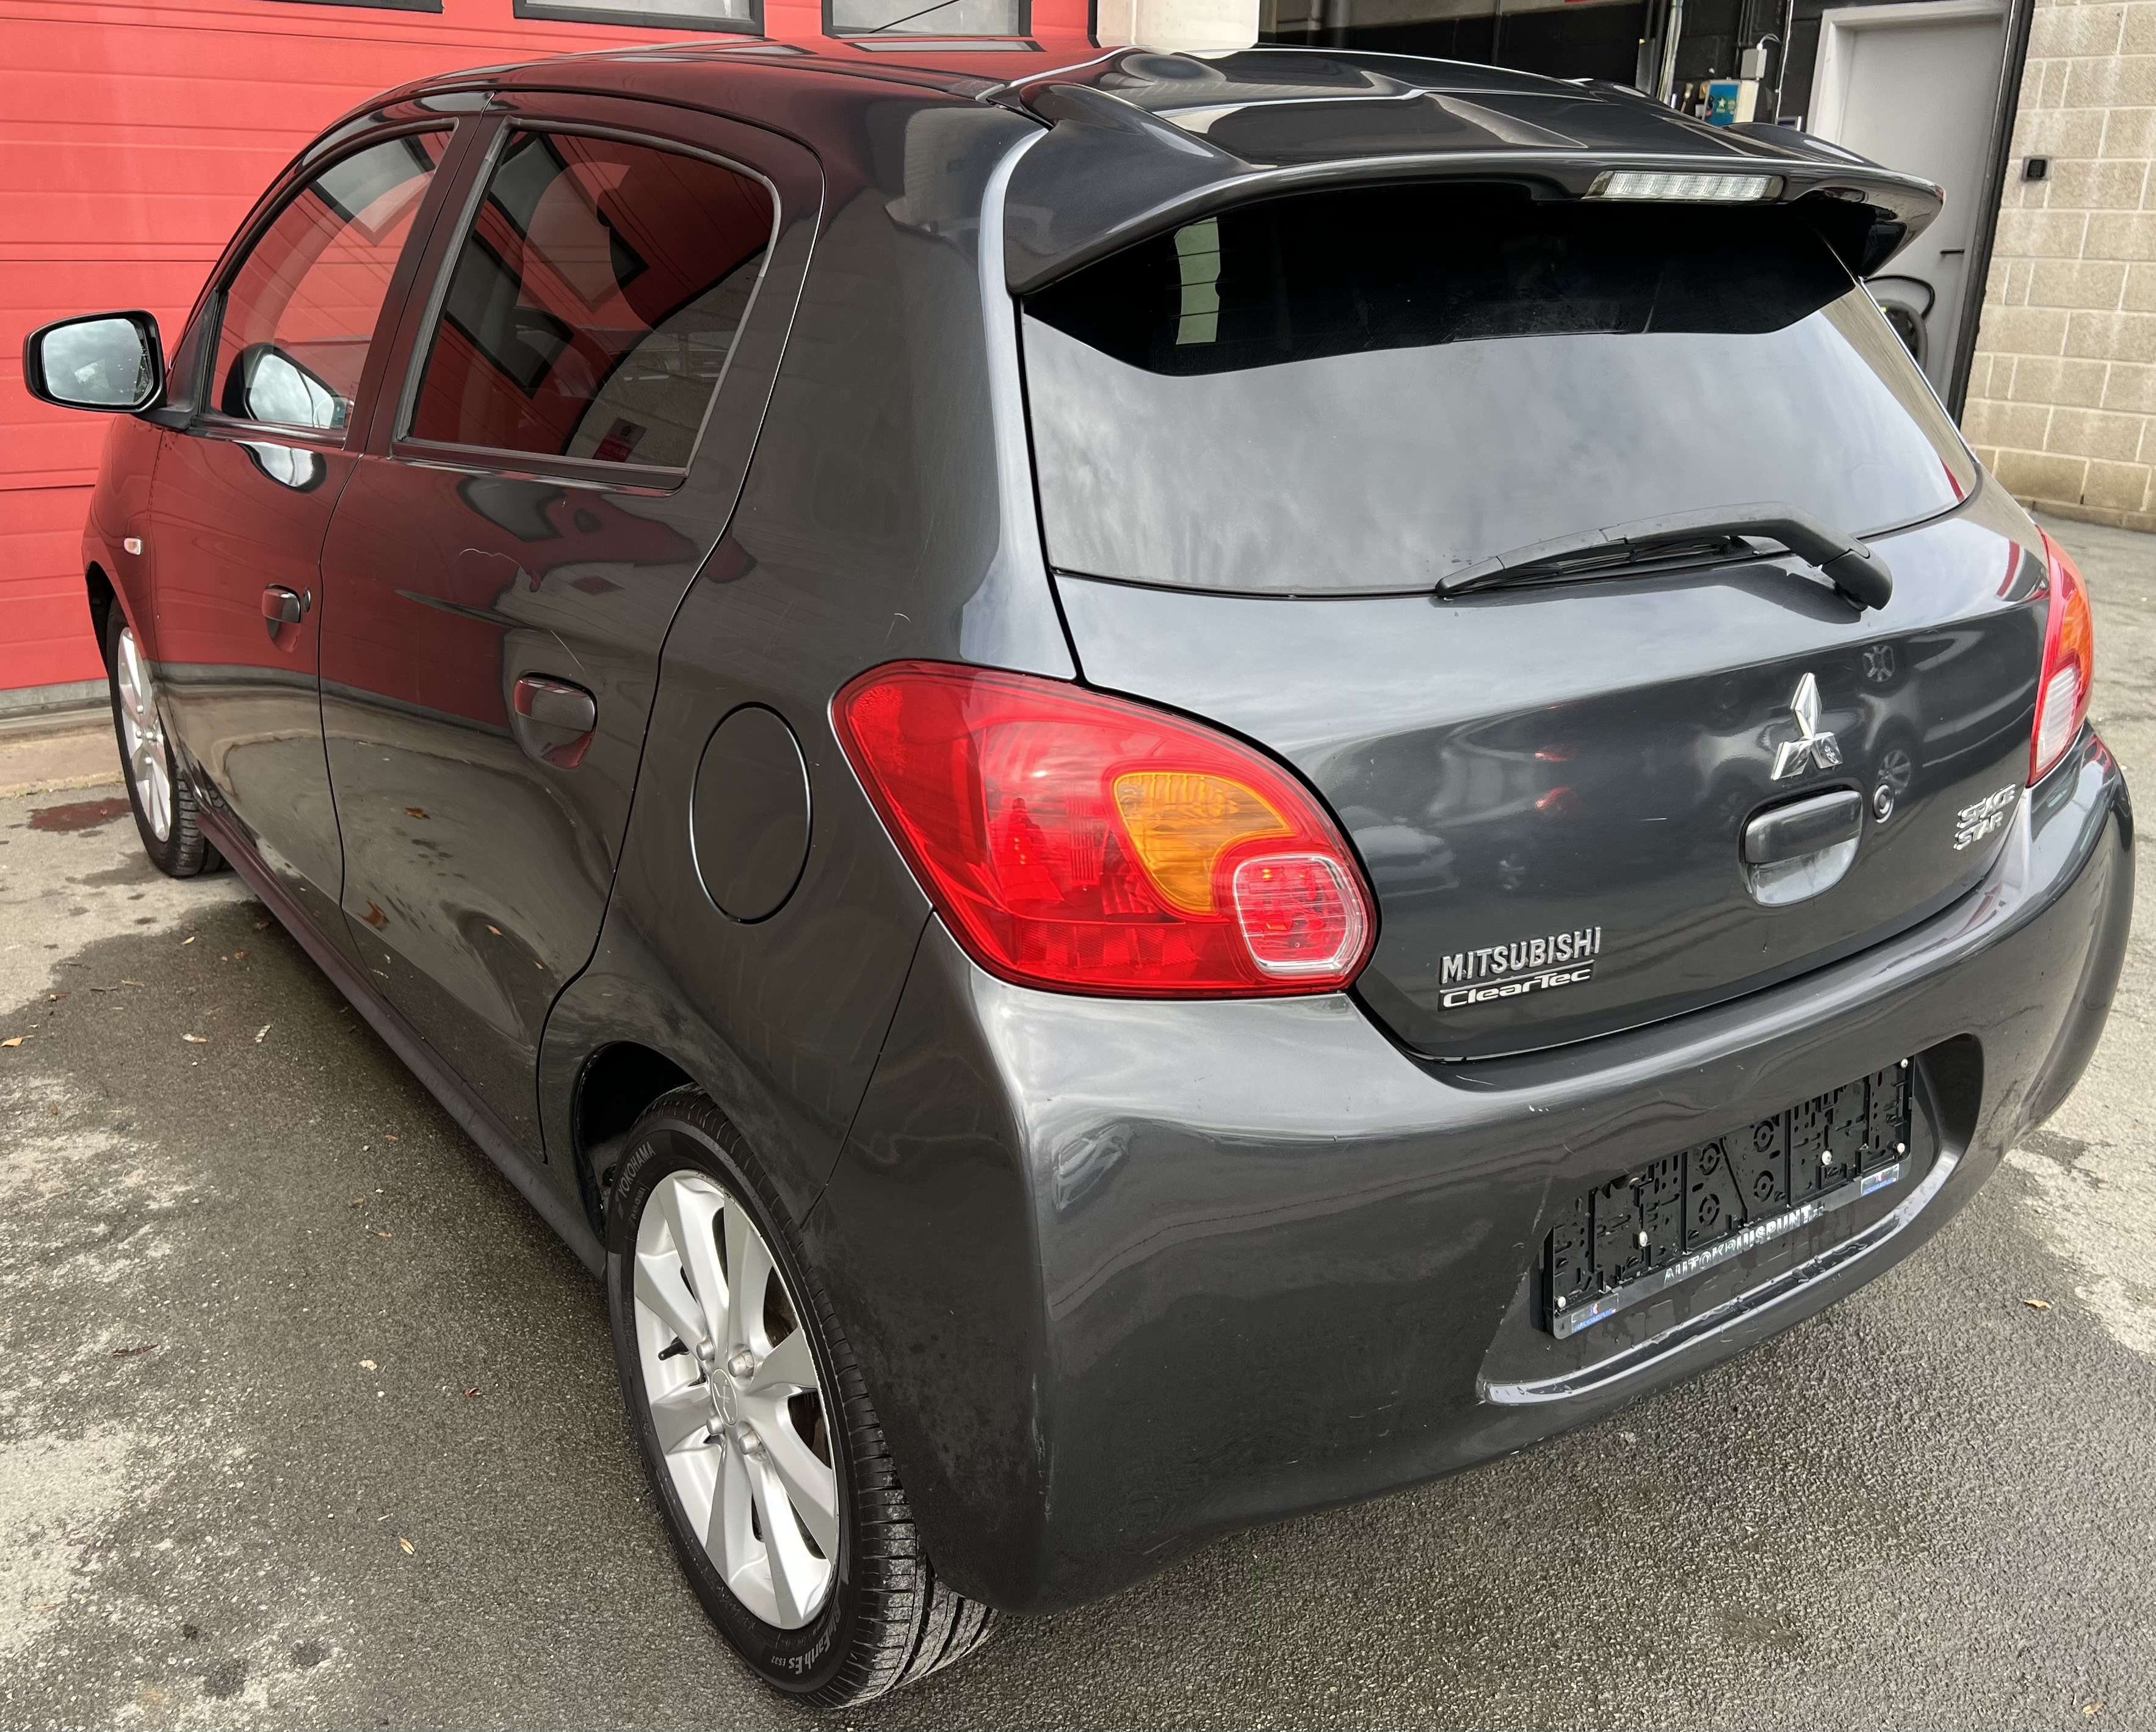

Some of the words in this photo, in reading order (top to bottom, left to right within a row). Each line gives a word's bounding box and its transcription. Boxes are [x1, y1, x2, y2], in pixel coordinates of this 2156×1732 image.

[1958, 783, 2016, 828] SPACE
[1953, 811, 2003, 850] STAR
[1440, 926, 1601, 984] MITSUBISHI
[1442, 969, 1591, 1008] ClearTec
[618, 1141, 656, 1198] YOKOHAMA
[771, 1655, 786, 1666] ES32
